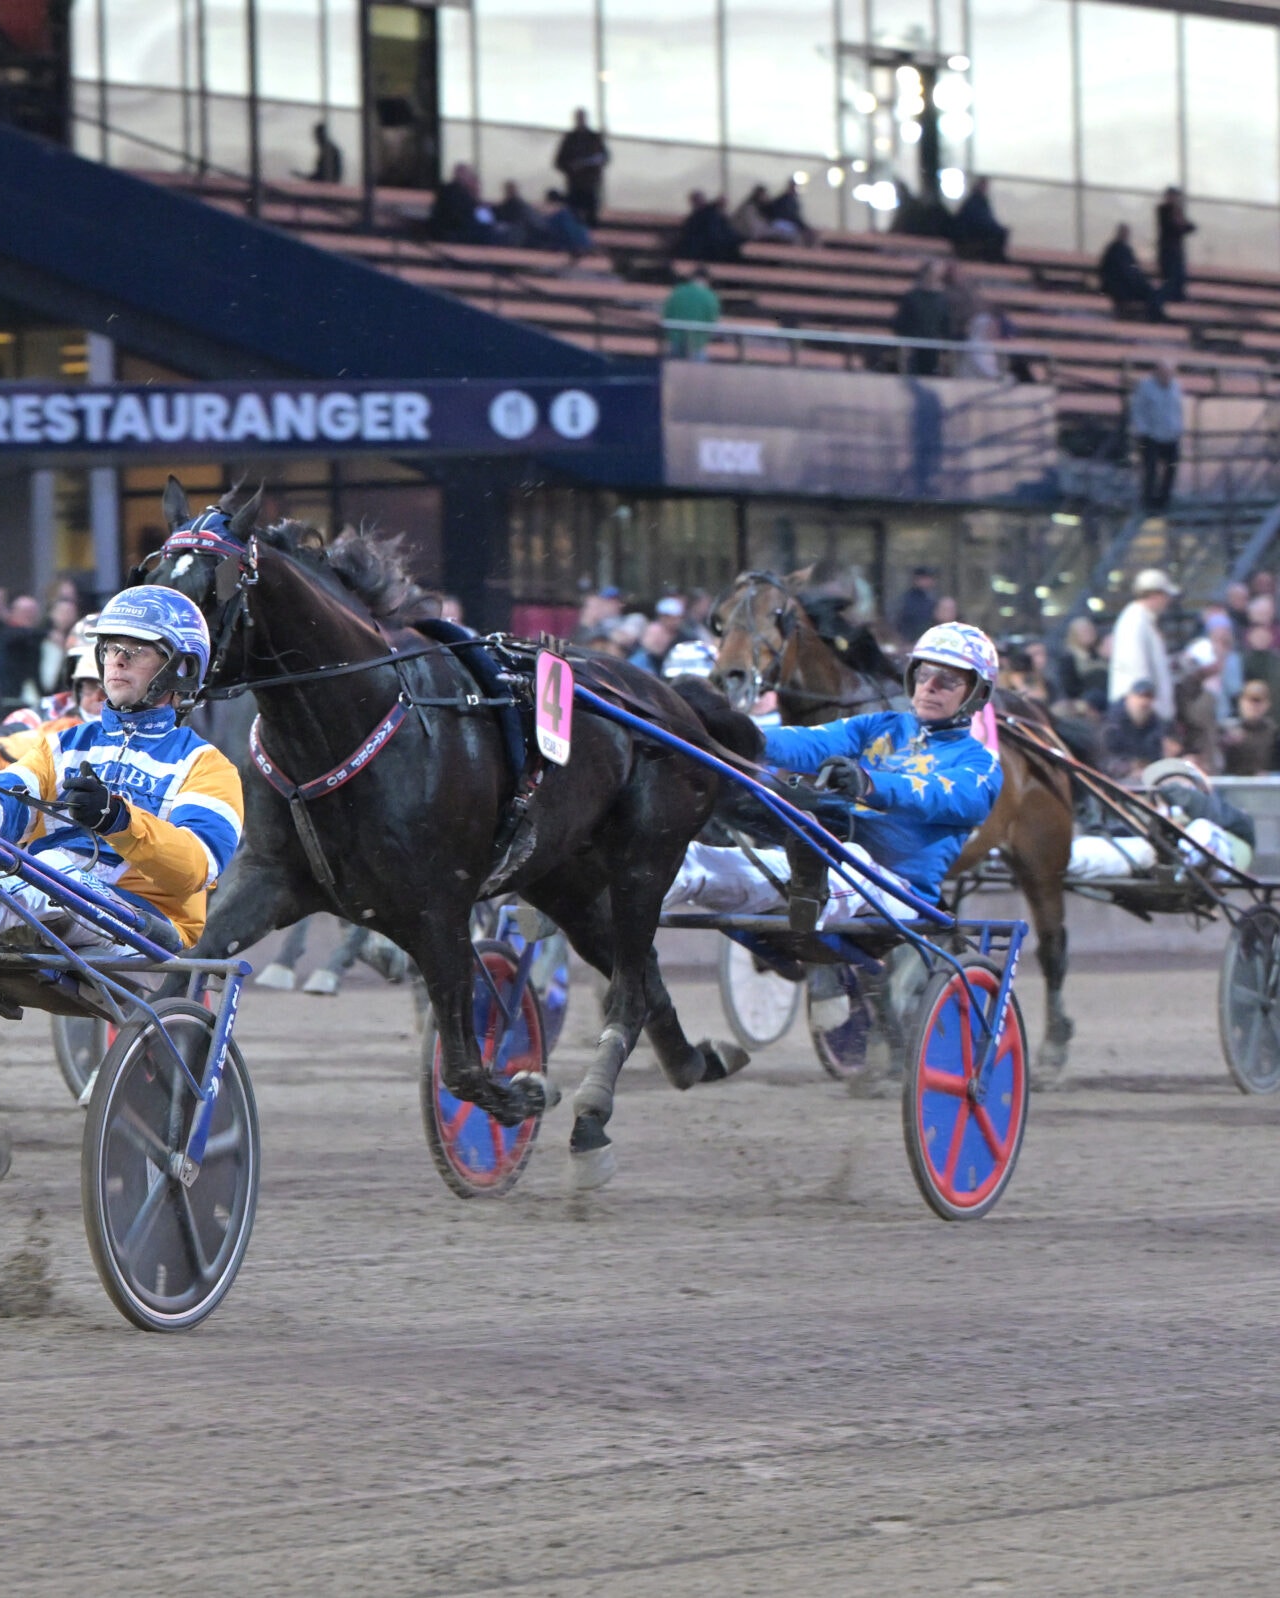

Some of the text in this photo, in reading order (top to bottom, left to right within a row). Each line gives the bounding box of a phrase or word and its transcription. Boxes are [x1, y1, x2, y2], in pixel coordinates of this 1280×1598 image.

[542, 660, 563, 733] 4
[327, 720, 394, 787] NATORP BO
